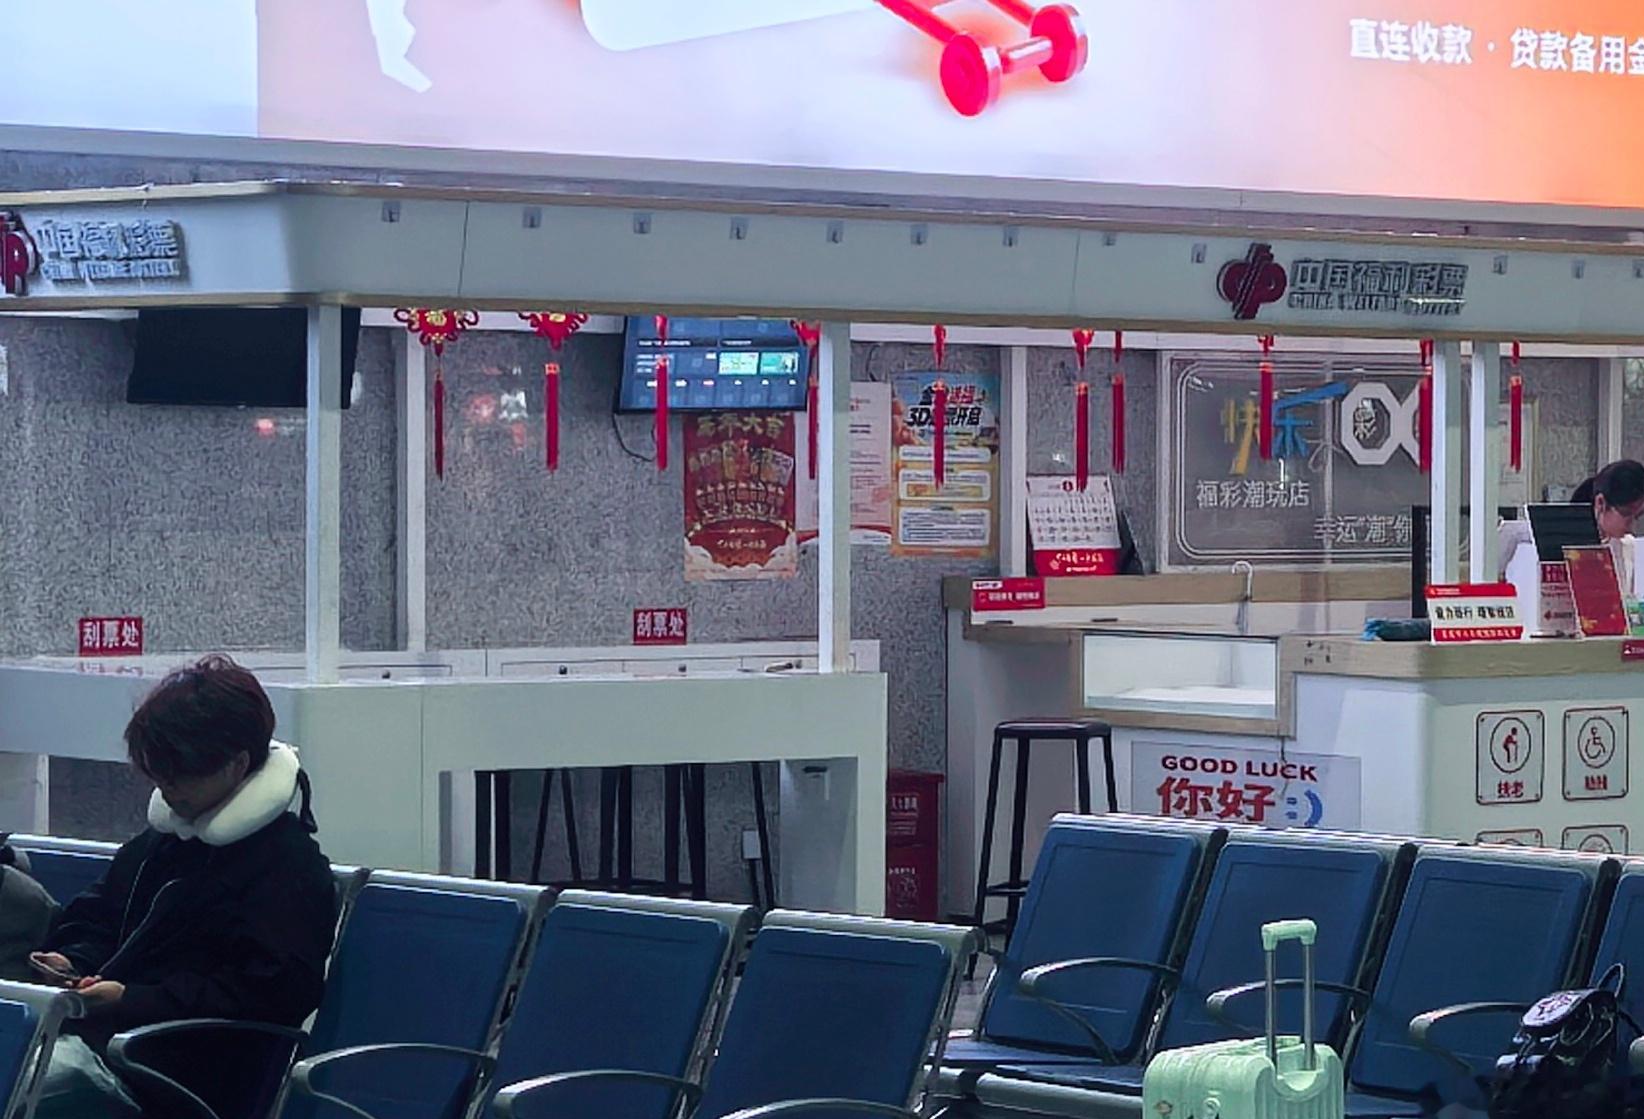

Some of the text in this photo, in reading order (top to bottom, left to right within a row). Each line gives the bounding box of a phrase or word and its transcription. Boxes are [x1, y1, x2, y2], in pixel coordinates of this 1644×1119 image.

[1349, 18, 1472, 64] 直连收款
[1291, 258, 1468, 298] 中国福利彩票
[1196, 480, 1310, 509] 福彩潮玩店
[83, 620, 139, 648] 刮票处
[636, 611, 685, 638] 刮票处
[1161, 755, 1318, 782] GOOD LUCK
[1156, 775, 1276, 823] 你好
